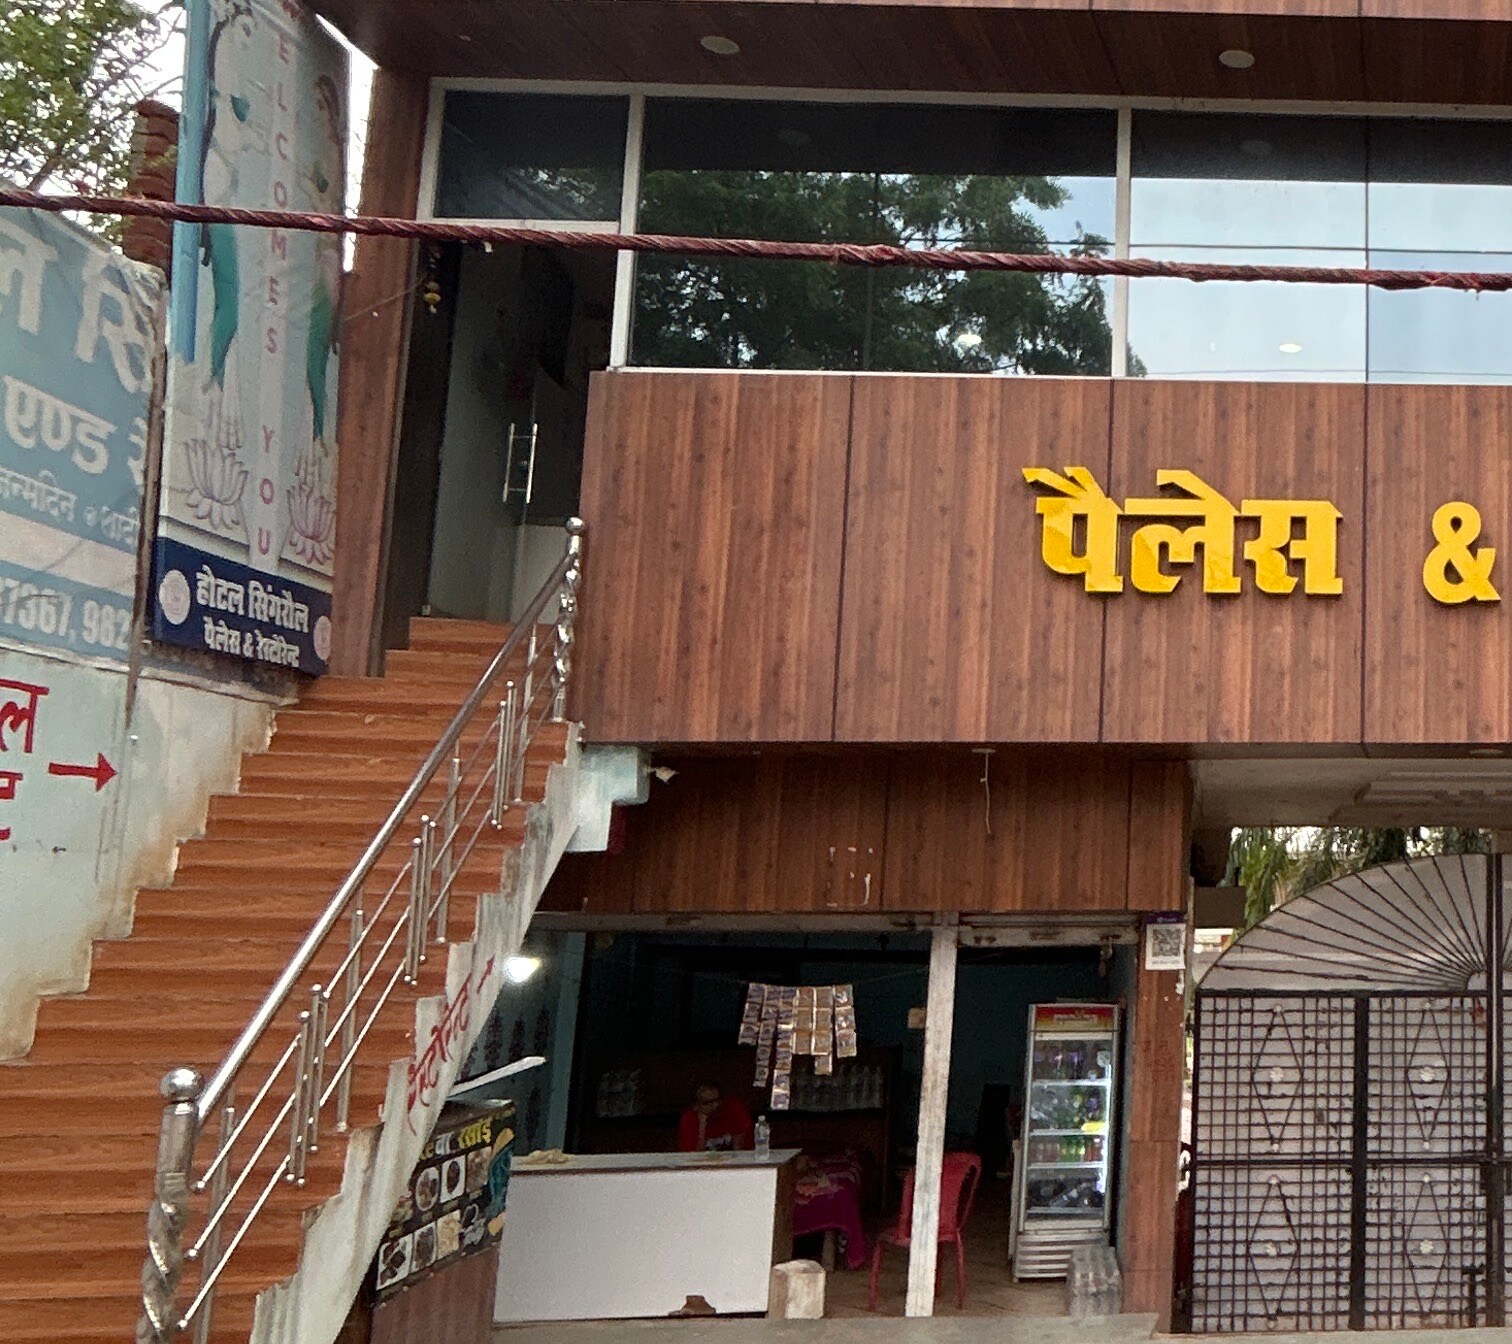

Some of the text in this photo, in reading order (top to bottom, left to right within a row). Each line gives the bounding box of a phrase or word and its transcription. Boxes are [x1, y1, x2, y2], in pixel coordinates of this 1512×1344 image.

[4, 374, 118, 474] एण्ड
[257, 425, 276, 555] YOU
[1022, 466, 1344, 596] पैलेस
[1423, 501, 1501, 605] &
[196, 564, 245, 616] होटल
[203, 615, 241, 655] पैलेस
[243, 632, 255, 658] &
